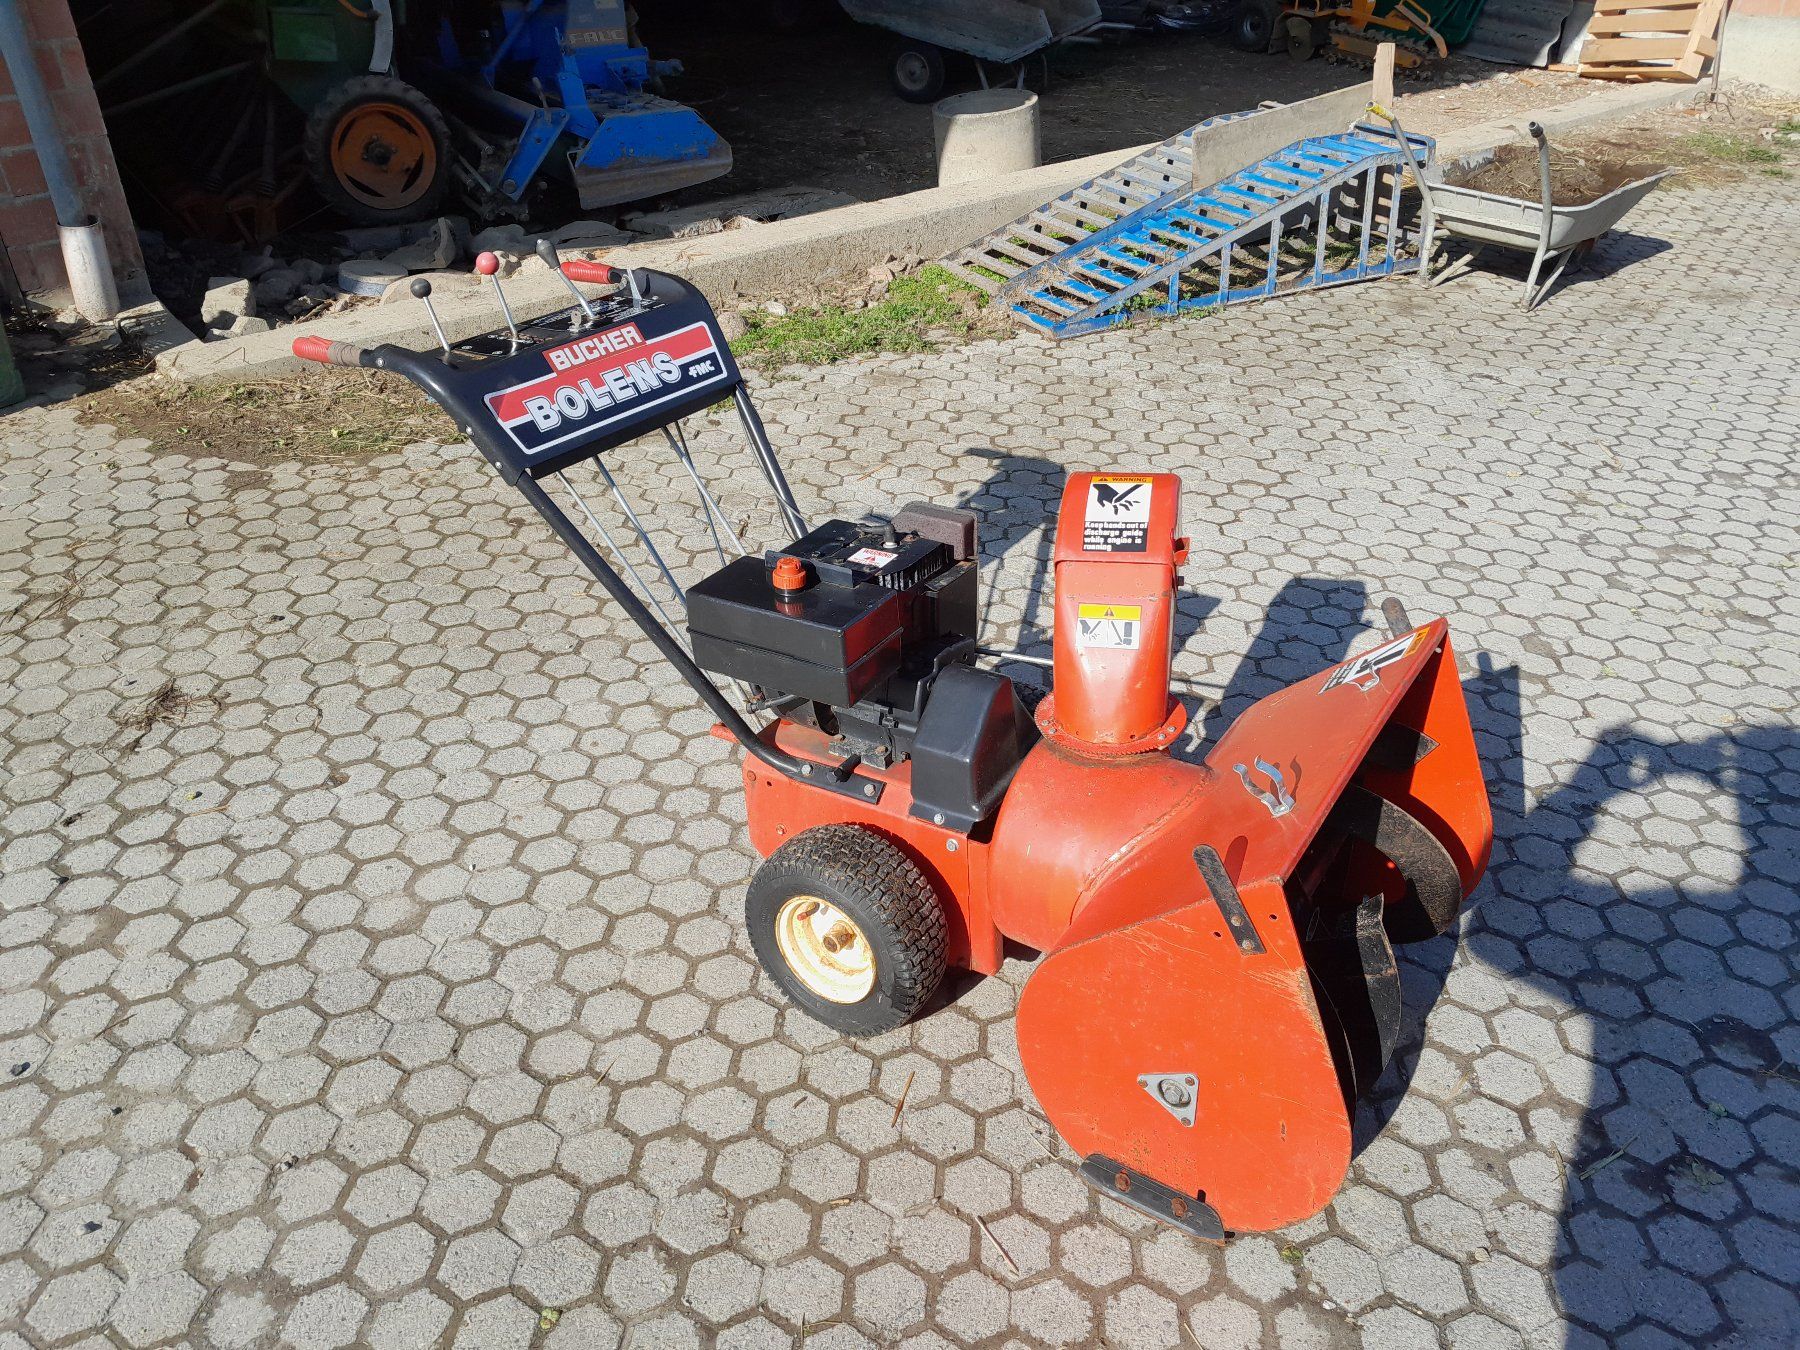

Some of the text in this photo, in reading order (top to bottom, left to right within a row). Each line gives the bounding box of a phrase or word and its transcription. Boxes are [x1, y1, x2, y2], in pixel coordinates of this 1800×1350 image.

[549, 325, 642, 371] BUCHER
[523, 352, 682, 433] BOLENS
[1084, 528, 1143, 537] discharge guide
[1083, 543, 1112, 552] running
